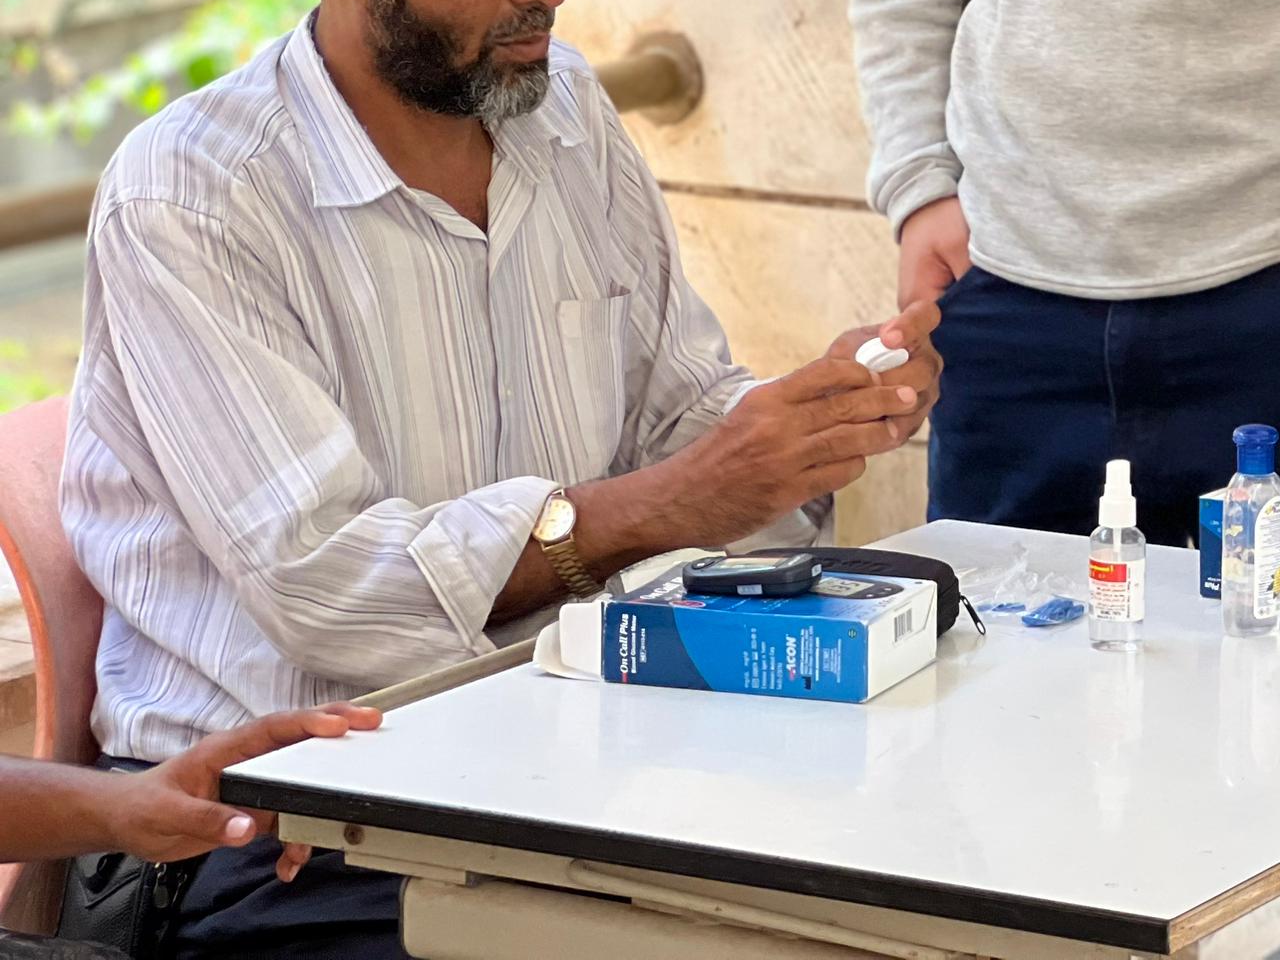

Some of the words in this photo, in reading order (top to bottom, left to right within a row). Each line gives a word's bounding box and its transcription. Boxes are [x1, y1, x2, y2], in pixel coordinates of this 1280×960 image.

[619, 613, 629, 635] Plus
[619, 637, 629, 657] Call
[785, 636, 797, 674] ACON
[619, 658, 629, 674] On
